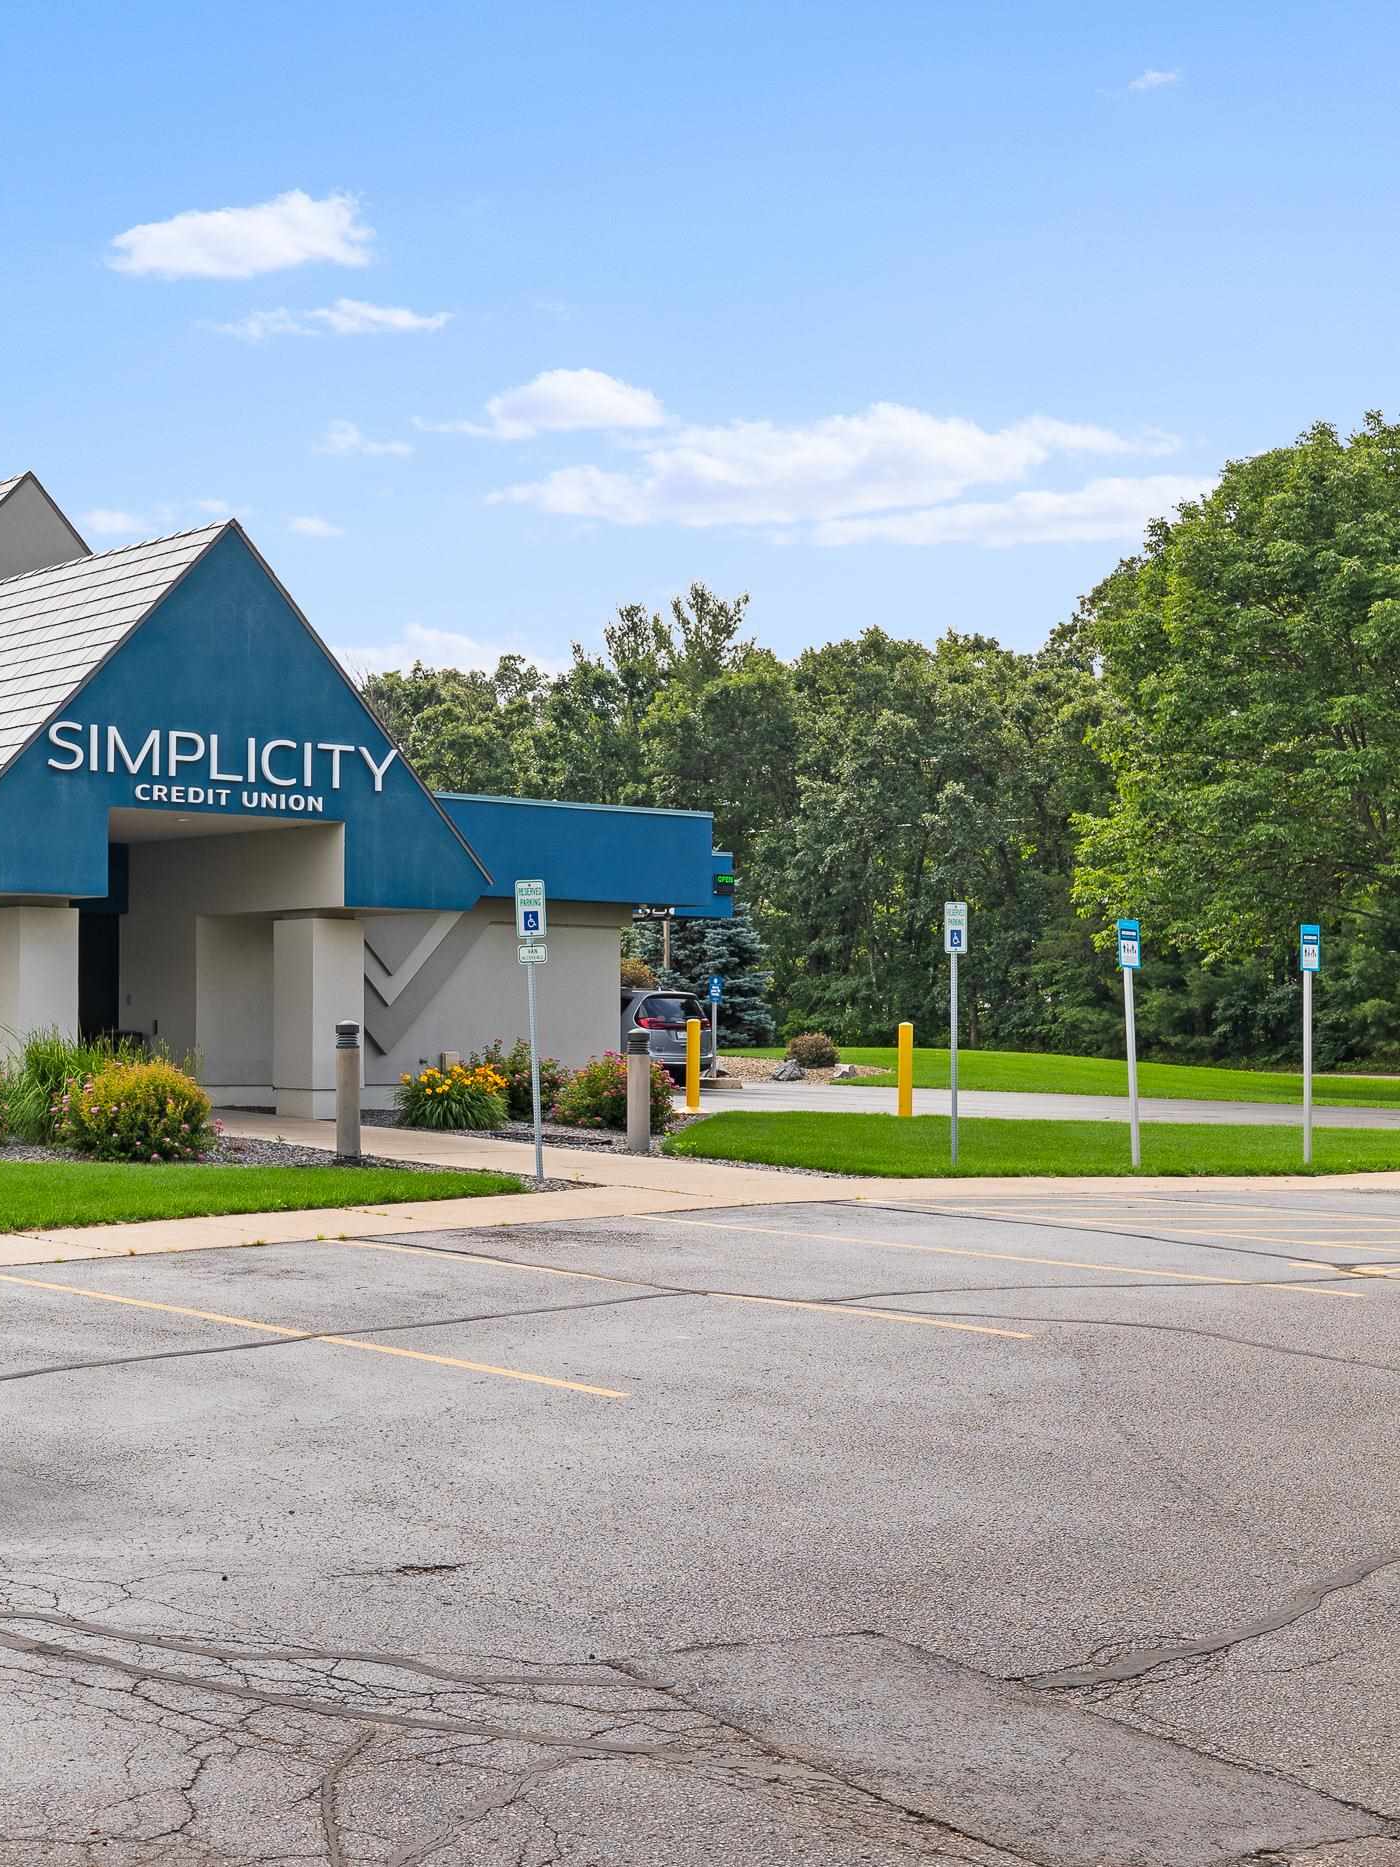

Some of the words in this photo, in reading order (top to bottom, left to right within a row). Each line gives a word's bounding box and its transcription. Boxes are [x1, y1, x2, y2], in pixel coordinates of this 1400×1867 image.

[48, 720, 399, 792] SIMPLICITY
[134, 783, 232, 807] CREDIT
[241, 791, 324, 812] UNION
[717, 875, 734, 884] OPEN
[519, 898, 541, 907] PARKING
